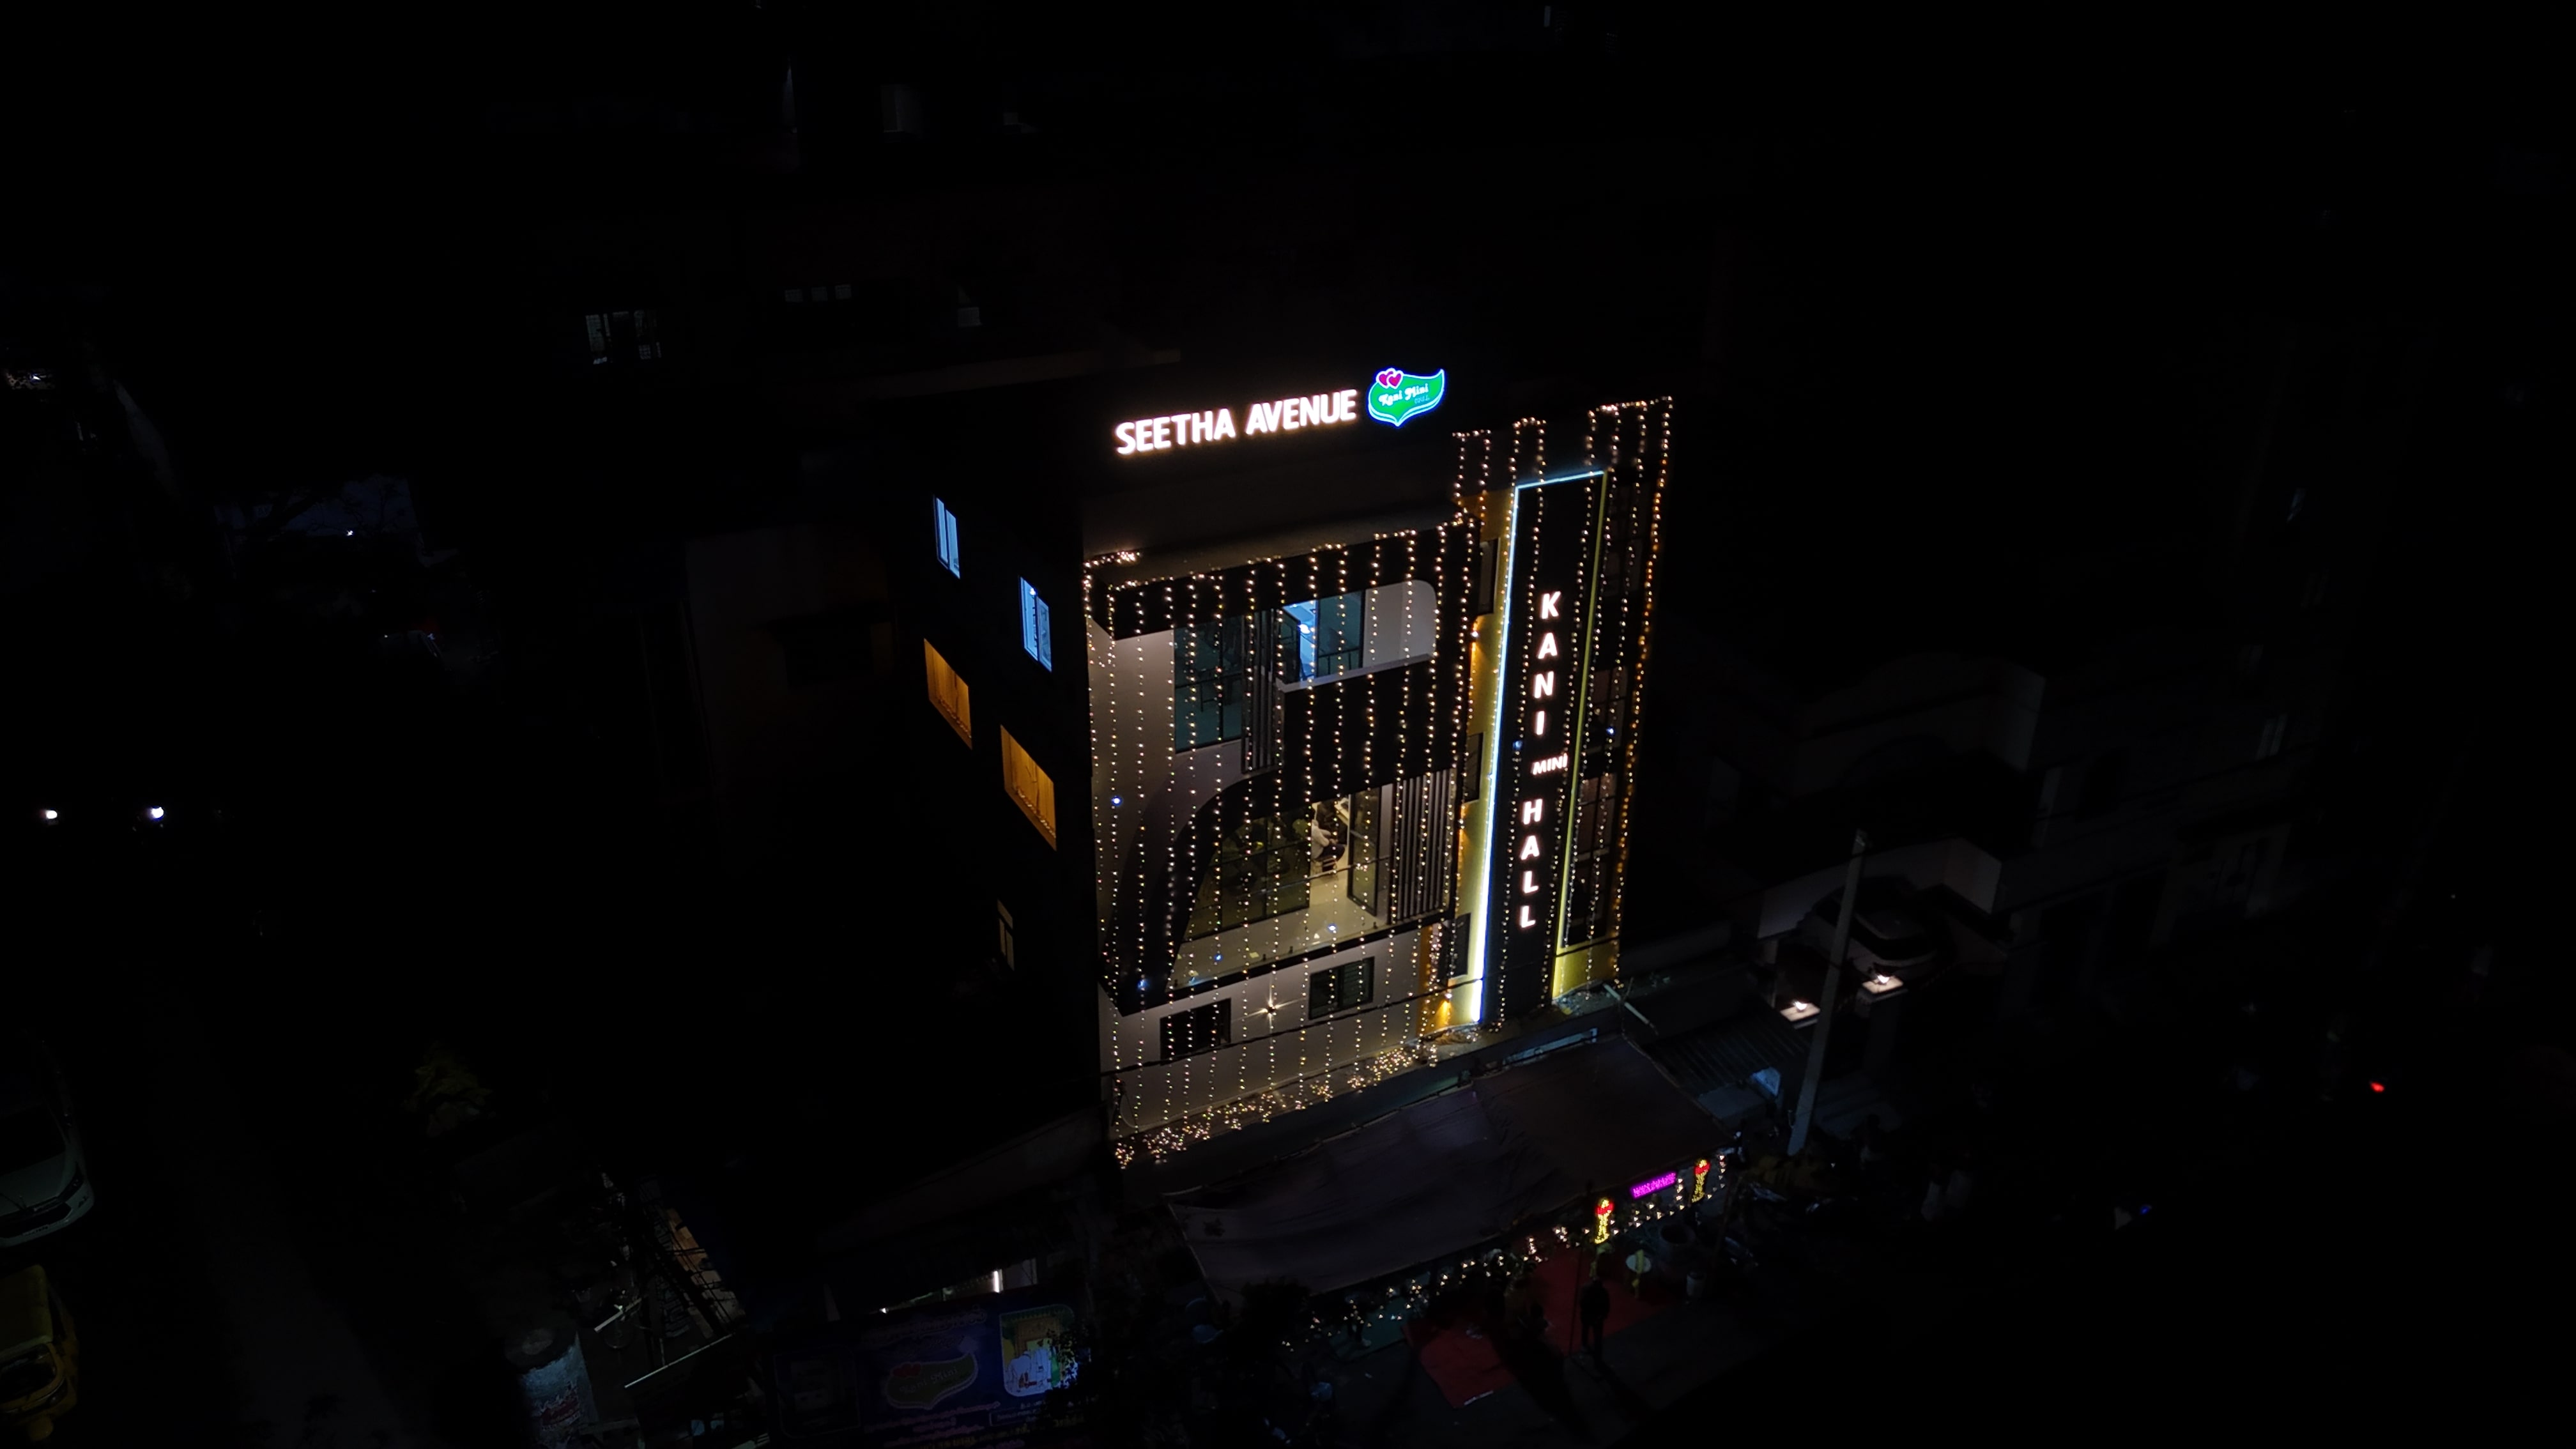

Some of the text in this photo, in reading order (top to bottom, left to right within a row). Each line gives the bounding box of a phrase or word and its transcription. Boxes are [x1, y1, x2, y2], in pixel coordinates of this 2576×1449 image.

[1116, 389, 1357, 455] SEETHA AVENUE
[1378, 390, 1402, 406] Kani
[1404, 383, 1429, 401] Mini
[1519, 591, 1568, 928] KANI MINI HALL
